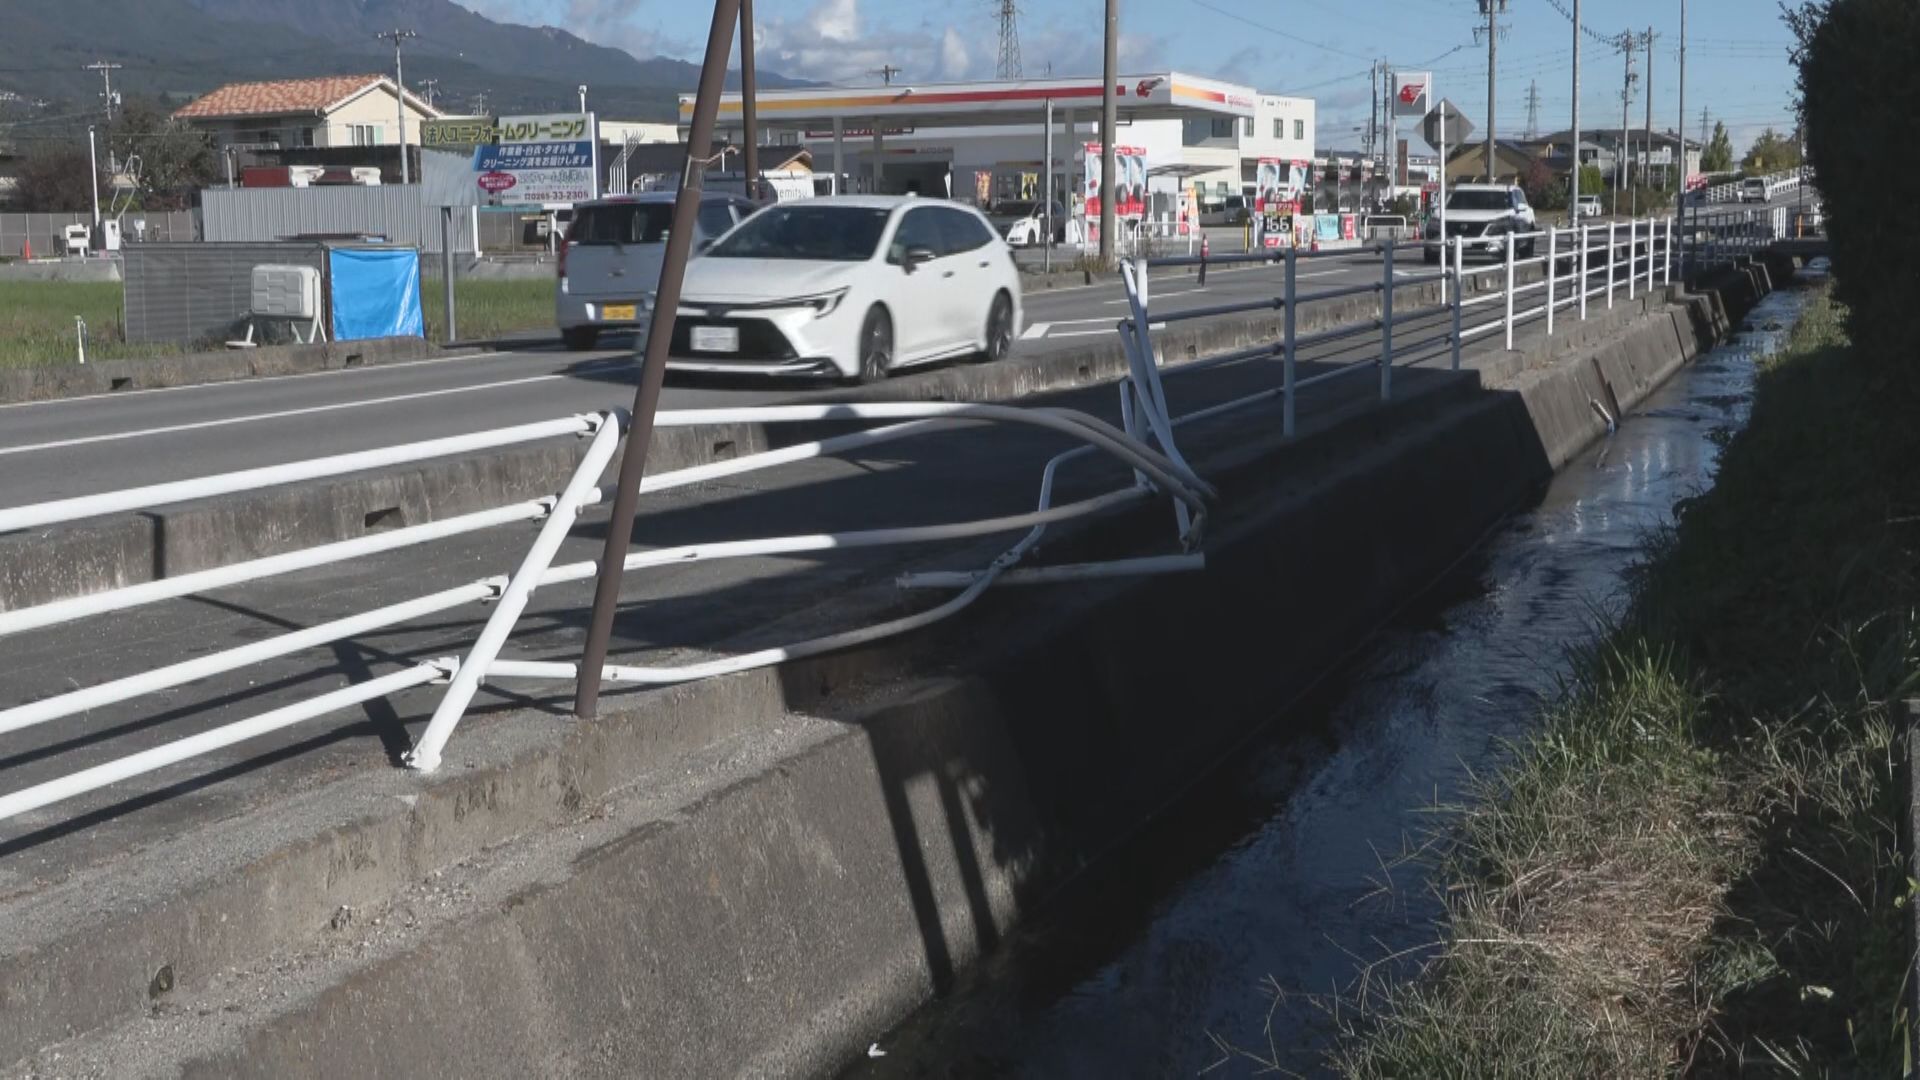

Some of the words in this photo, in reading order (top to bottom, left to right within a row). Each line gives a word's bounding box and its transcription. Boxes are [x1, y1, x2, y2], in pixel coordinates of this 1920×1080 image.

[425, 119, 587, 145] 法人ユニフォームクリーニング
